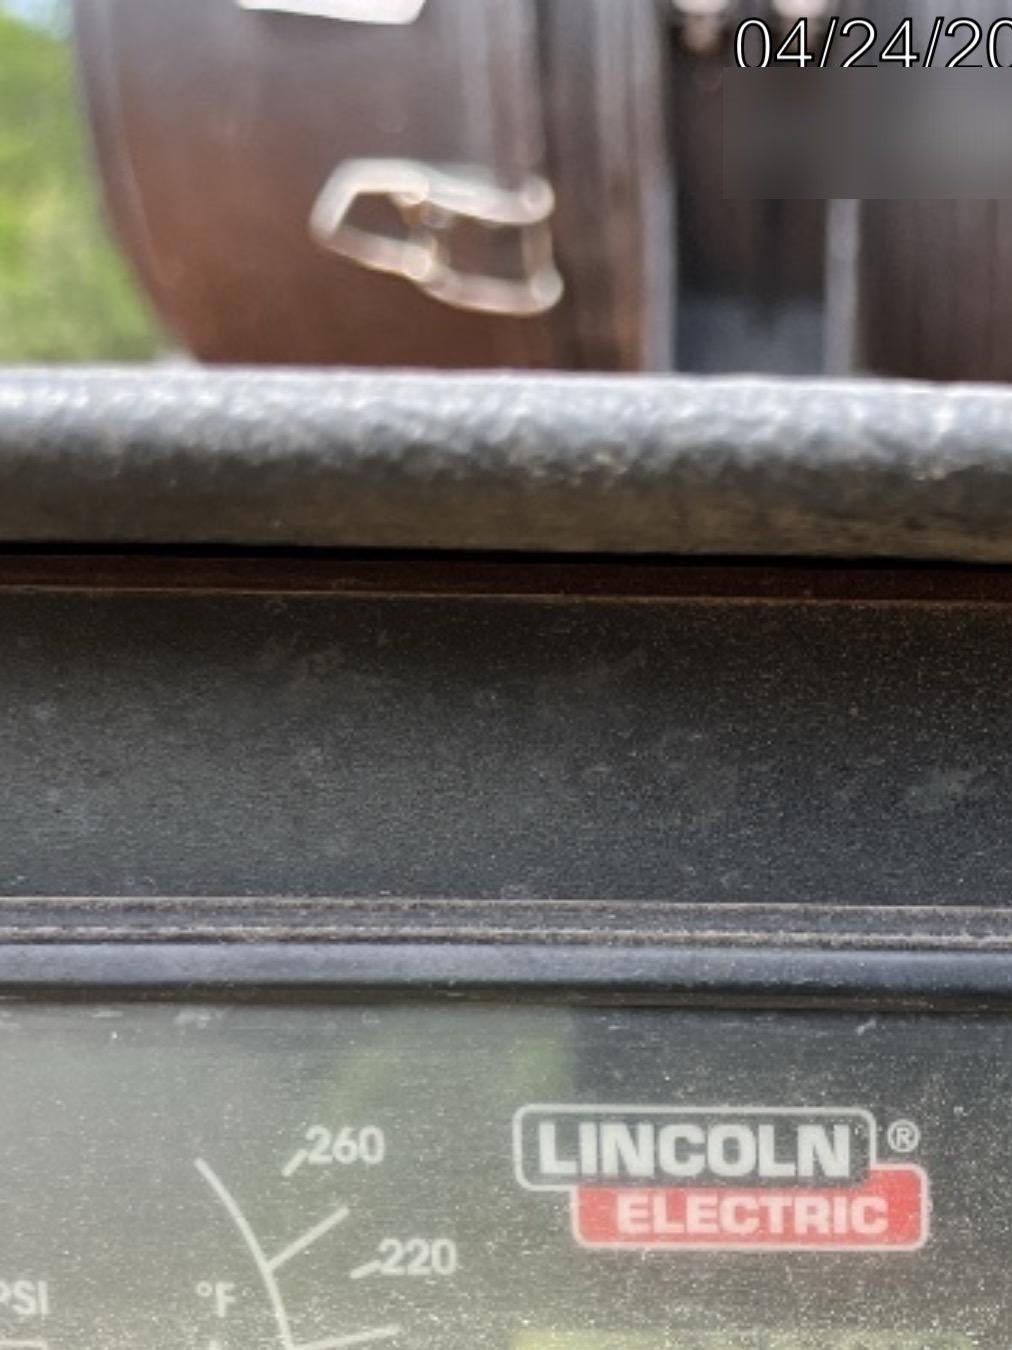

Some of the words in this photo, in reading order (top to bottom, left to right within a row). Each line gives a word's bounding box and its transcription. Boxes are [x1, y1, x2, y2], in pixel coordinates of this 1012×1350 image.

[305, 1126, 385, 1164] 260
[537, 1121, 850, 1177] LINCOLN
[616, 1195, 888, 1234] ELECTRIC
[378, 1238, 457, 1276] 220
